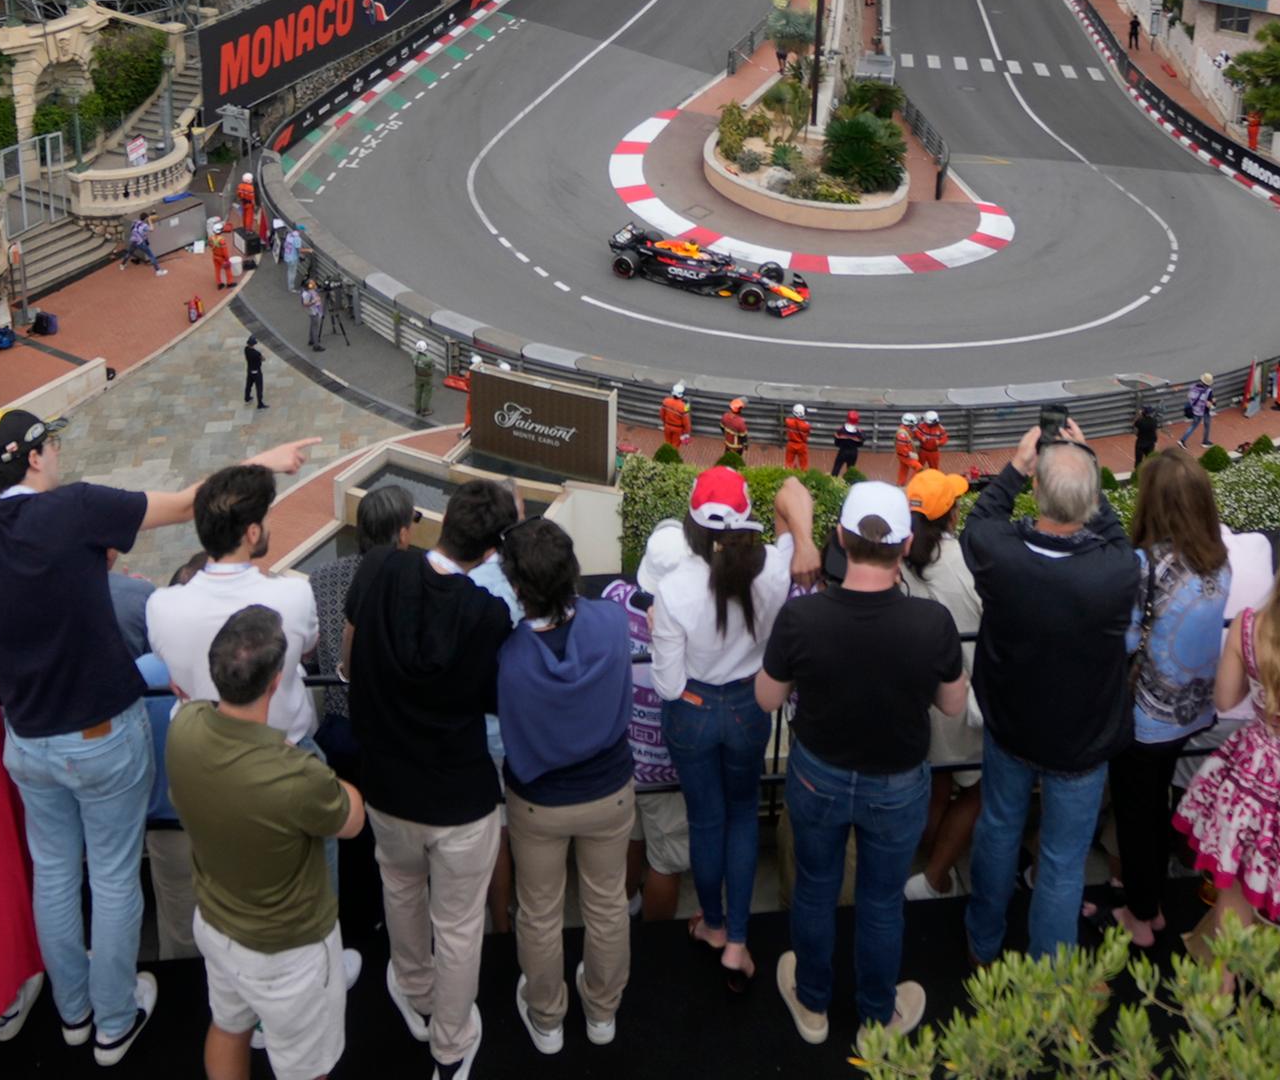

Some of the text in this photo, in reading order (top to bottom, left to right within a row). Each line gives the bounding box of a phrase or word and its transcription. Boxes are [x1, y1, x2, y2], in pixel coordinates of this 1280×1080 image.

[345, 120, 403, 168] TAXIS
[667, 266, 707, 280] ORACLE
[494, 401, 577, 442] Fairmont
[512, 430, 560, 447] MONTE CARLO
